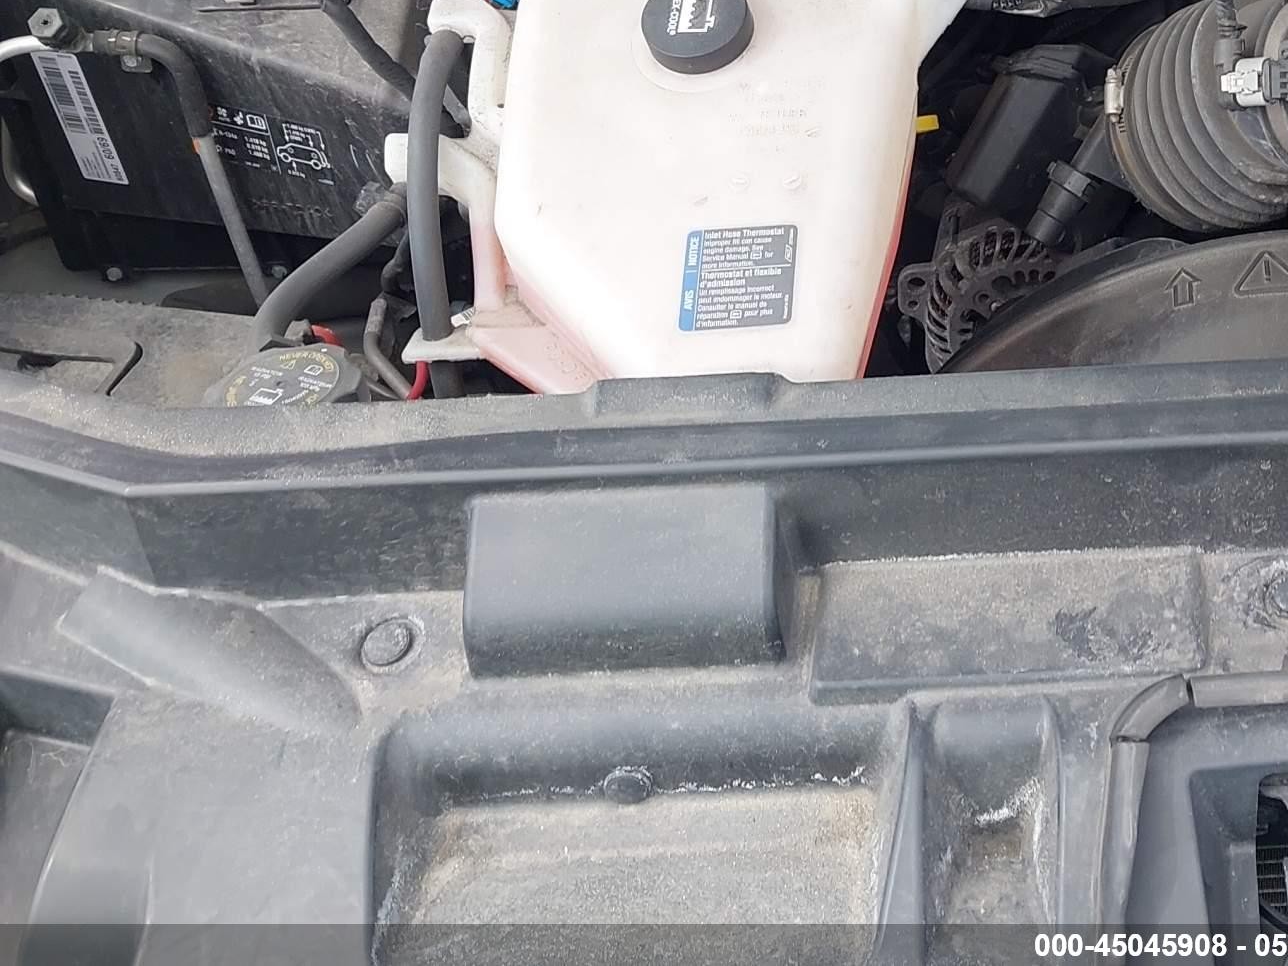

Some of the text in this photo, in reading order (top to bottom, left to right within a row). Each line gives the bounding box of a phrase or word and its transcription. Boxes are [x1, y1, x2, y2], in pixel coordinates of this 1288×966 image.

[722, 230, 741, 238] Hose
[742, 228, 784, 237] Thermostat
[688, 236, 700, 266] NOTICE
[700, 270, 744, 280] Thermostat
[684, 290, 694, 310] AVIS
